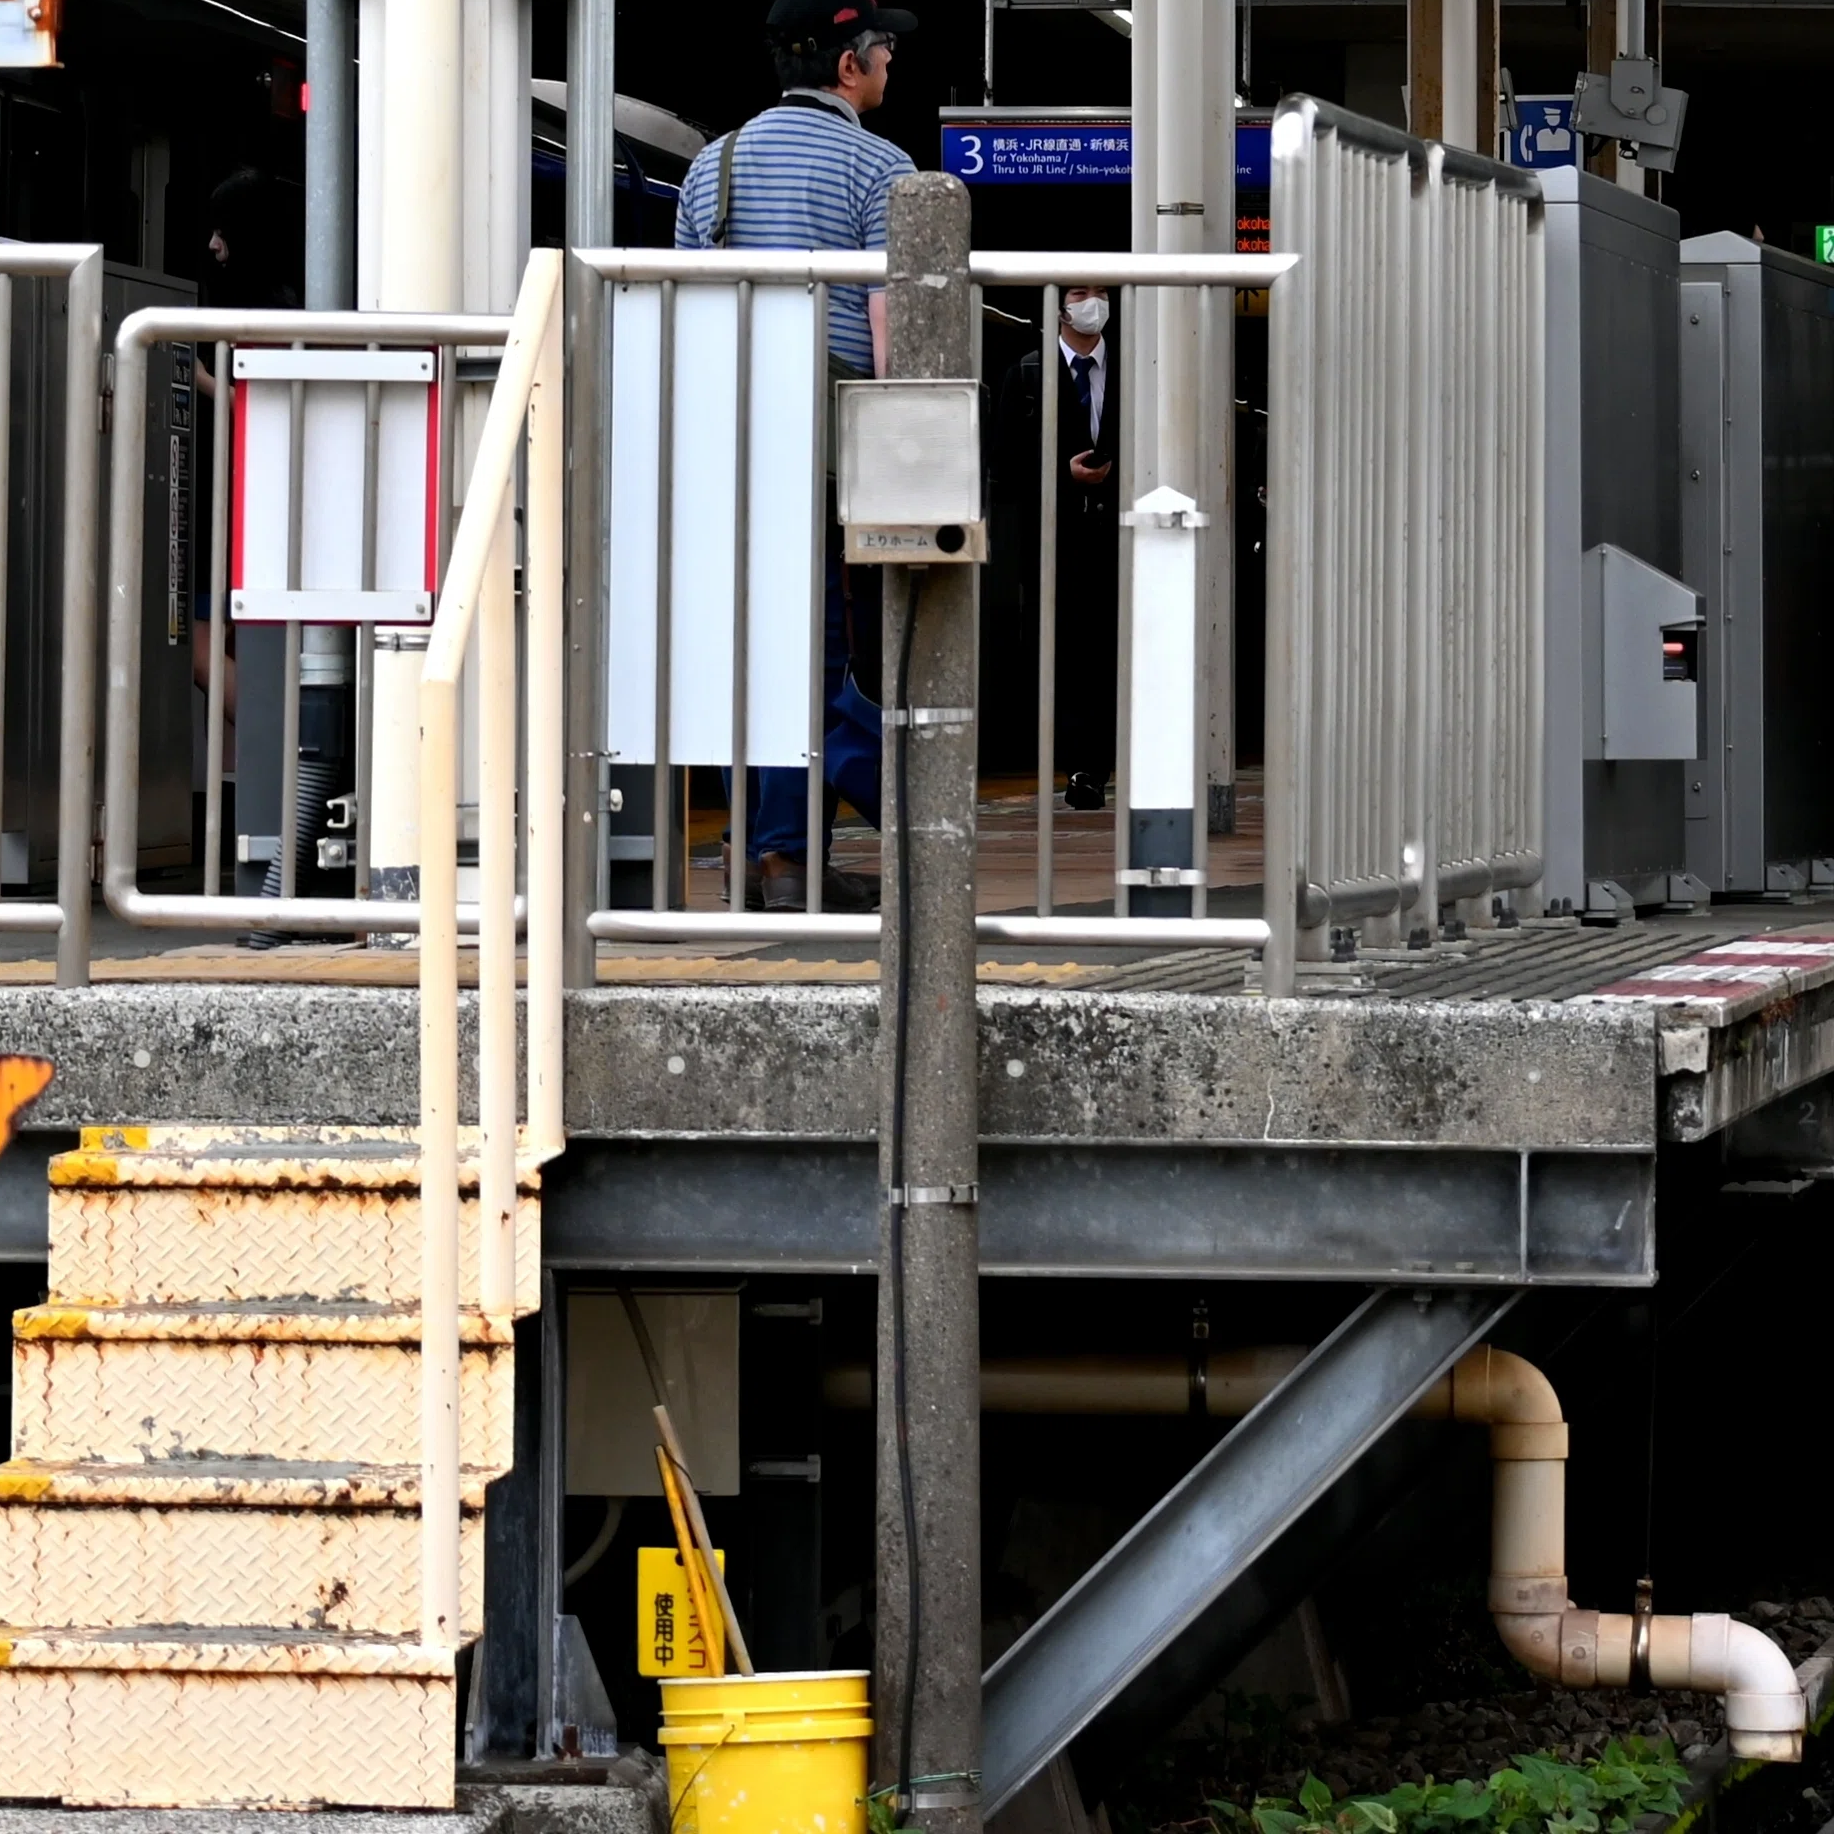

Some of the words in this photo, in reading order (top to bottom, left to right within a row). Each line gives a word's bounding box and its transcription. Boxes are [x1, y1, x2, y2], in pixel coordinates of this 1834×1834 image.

[960, 135, 984, 175] 3
[992, 153, 1007, 163] for
[1010, 153, 1062, 163] Yokohama
[992, 165, 1016, 175] Thru
[1019, 165, 1029, 175] to
[1031, 165, 1044, 175] JR
[1046, 164, 1067, 175] Line
[864, 533, 928, 547] 上りホーム
[1798, 1101, 1818, 1125] 2
[654, 1592, 674, 1668] 使用中
